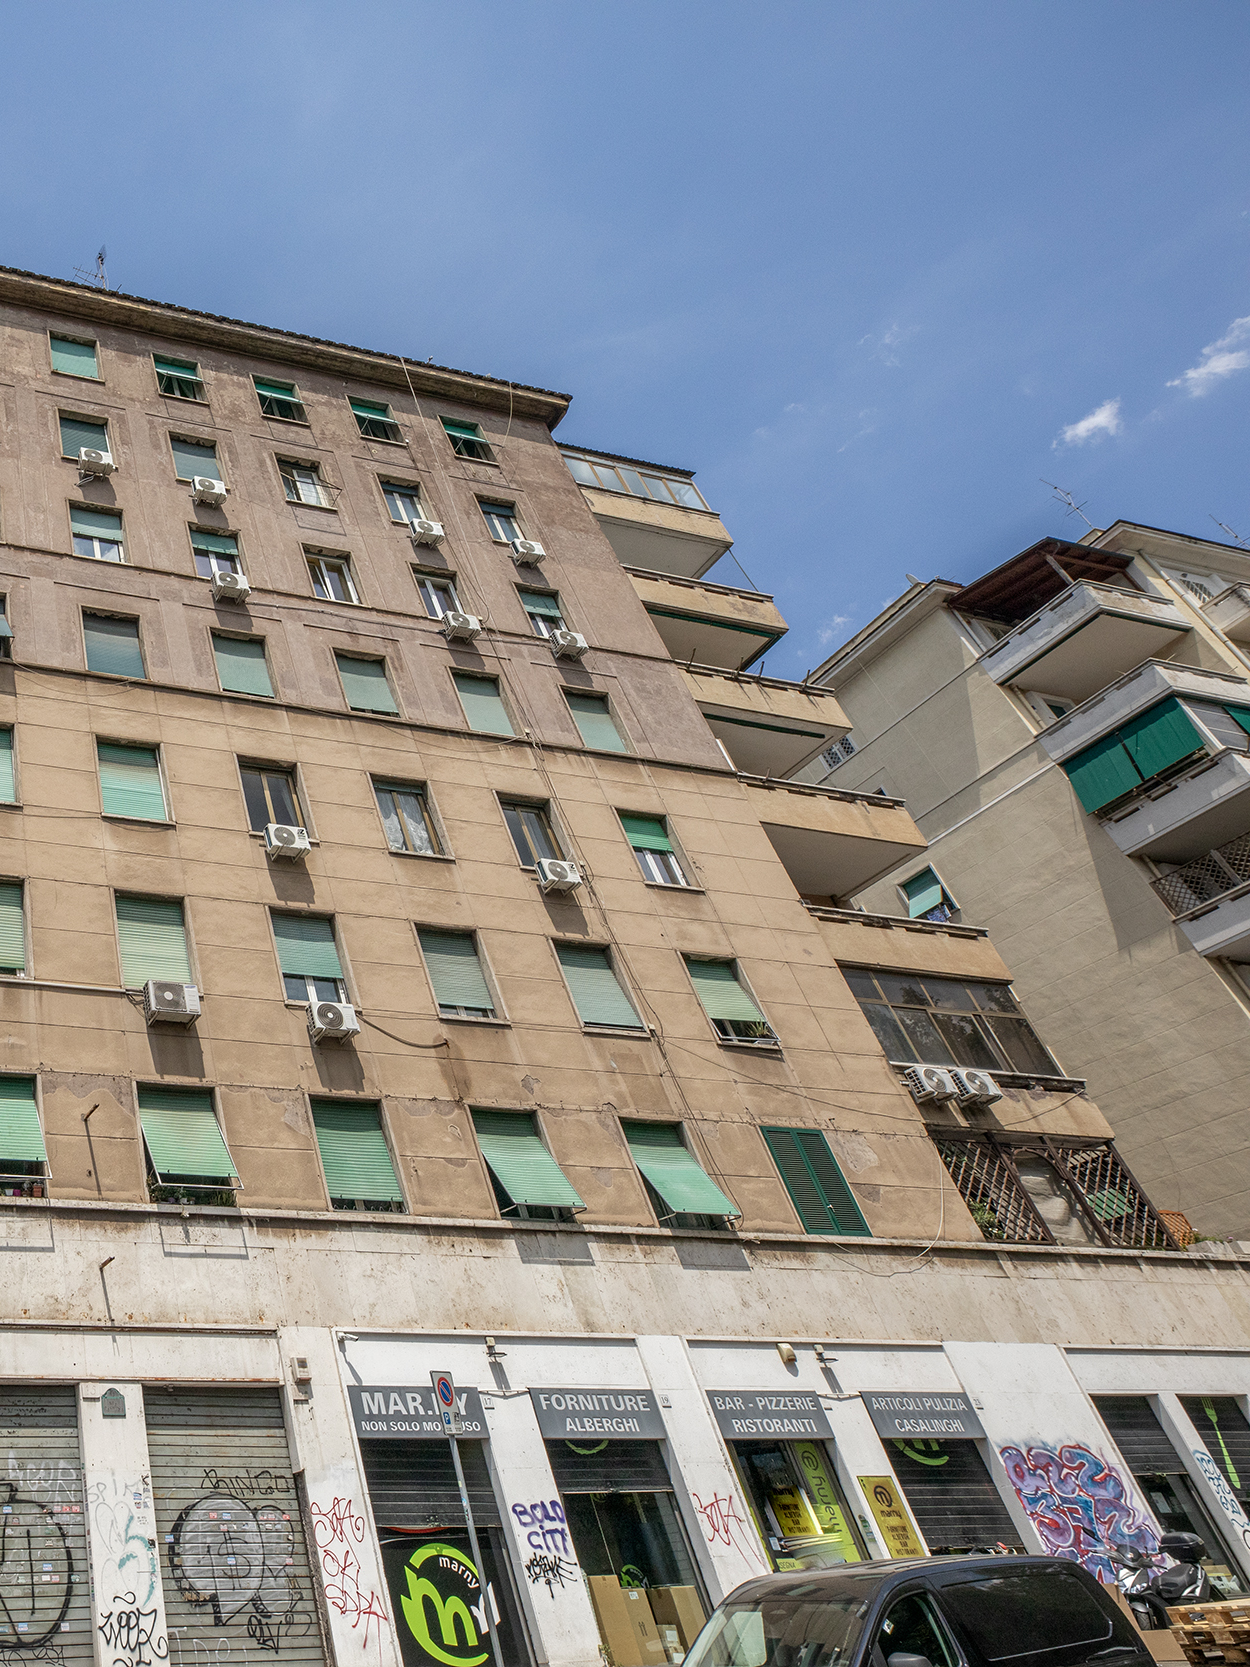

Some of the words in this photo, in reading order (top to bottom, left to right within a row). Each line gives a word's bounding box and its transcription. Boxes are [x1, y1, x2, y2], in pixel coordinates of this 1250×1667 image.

[360, 1392, 468, 1415] MAR.Y
[538, 1394, 651, 1411] FORNITURE
[713, 1396, 746, 1410] BAR
[755, 1396, 818, 1411] PIZZERIE
[871, 1397, 924, 1411] ARTICOLI
[923, 1397, 969, 1411] PULIZIA
[361, 1421, 388, 1431] NON
[390, 1421, 421, 1431] SOLO
[566, 1417, 641, 1432] ALBERGHI
[731, 1418, 818, 1433] RISTORANTI
[894, 1418, 966, 1433] CASALINGHI
[512, 1500, 566, 1527] BOLO
[438, 1556, 480, 1589] marny
